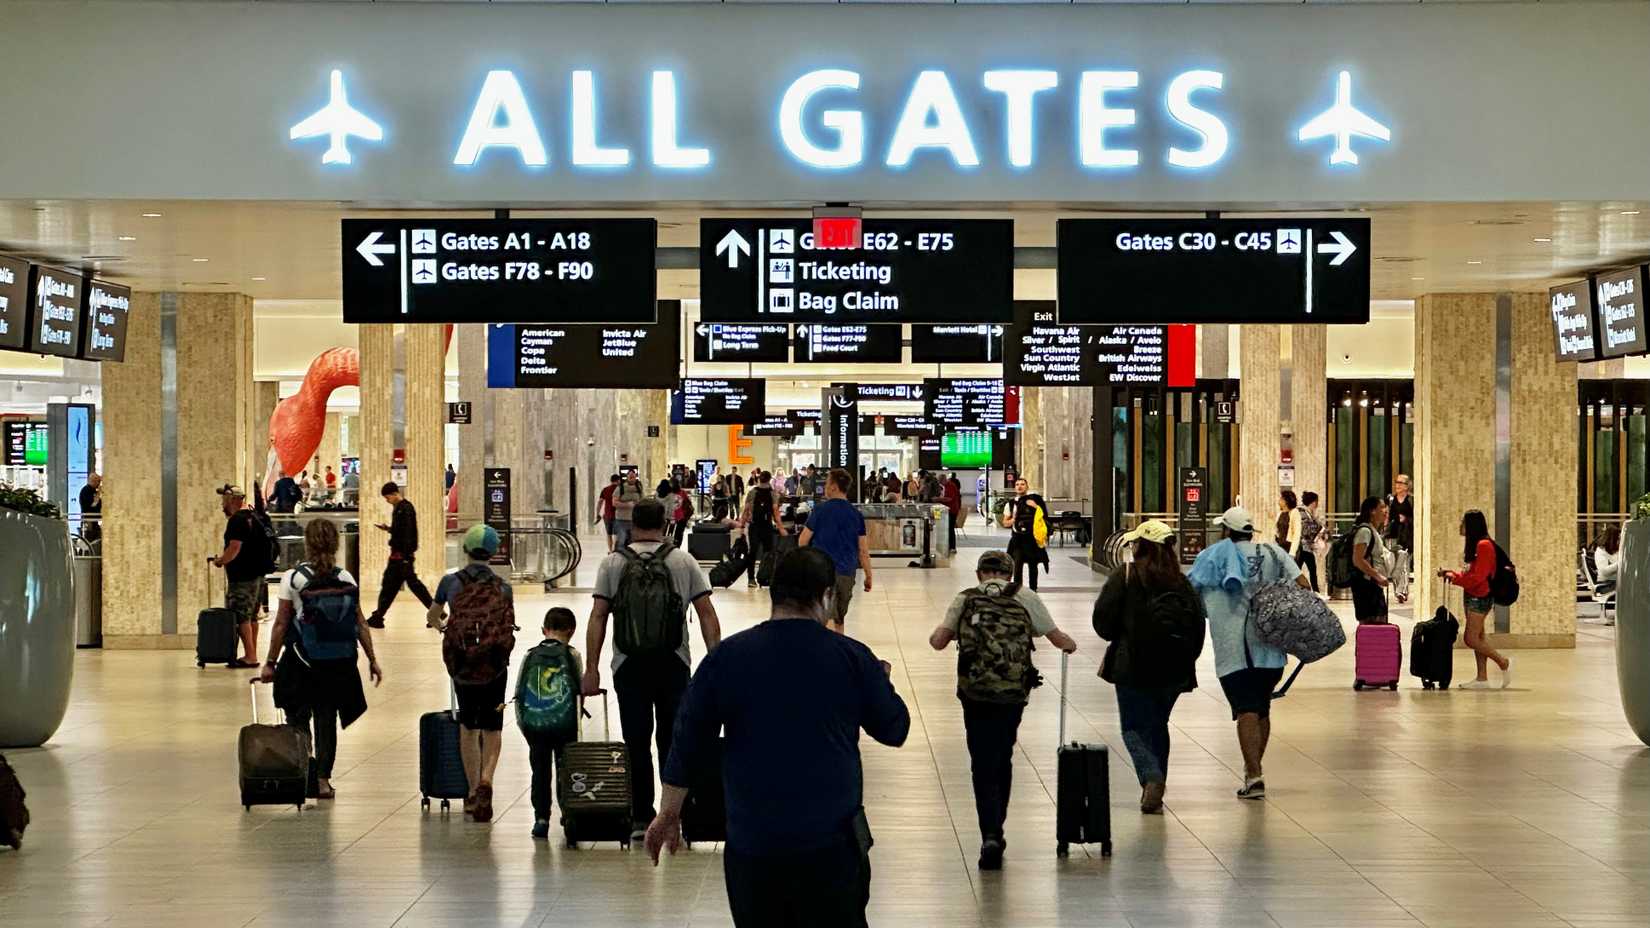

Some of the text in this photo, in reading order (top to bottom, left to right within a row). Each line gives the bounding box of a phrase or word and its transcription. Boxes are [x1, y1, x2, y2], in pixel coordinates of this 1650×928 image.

[453, 69, 1228, 168] ALL GATES
[442, 233, 499, 250] Gates
[504, 233, 530, 249] A1
[551, 232, 590, 249] A18
[864, 233, 898, 250] E62
[918, 233, 953, 250] E75
[1116, 233, 1173, 250] Gates
[1179, 233, 1216, 250] C30
[1235, 233, 1271, 250] C45
[442, 263, 499, 280] Gates
[505, 262, 540, 279] F78
[559, 262, 593, 279] F90
[799, 261, 891, 284] Ticketing
[799, 291, 898, 313] Bag Claim
[1035, 312, 1052, 320] Exit
[603, 329, 631, 337] Invicta
[1033, 327, 1080, 336] Havana Air
[521, 338, 553, 346] Cayman
[603, 339, 636, 347] JetBlue
[1022, 336, 1045, 344] Silver
[1058, 335, 1080, 344] Spirit
[1099, 336, 1127, 344] Alaska
[1137, 336, 1161, 344] Avelo
[521, 347, 545, 355] Copa
[603, 348, 633, 356] United
[1043, 354, 1080, 363] Country
[1099, 354, 1162, 363] British Airways
[521, 366, 557, 374] Frontier
[1021, 363, 1080, 373] Virgin Atlantic
[1118, 364, 1162, 372] Edelweiss
[857, 387, 894, 396] Ticketing
[728, 424, 753, 464] E
[839, 414, 849, 467] Information
